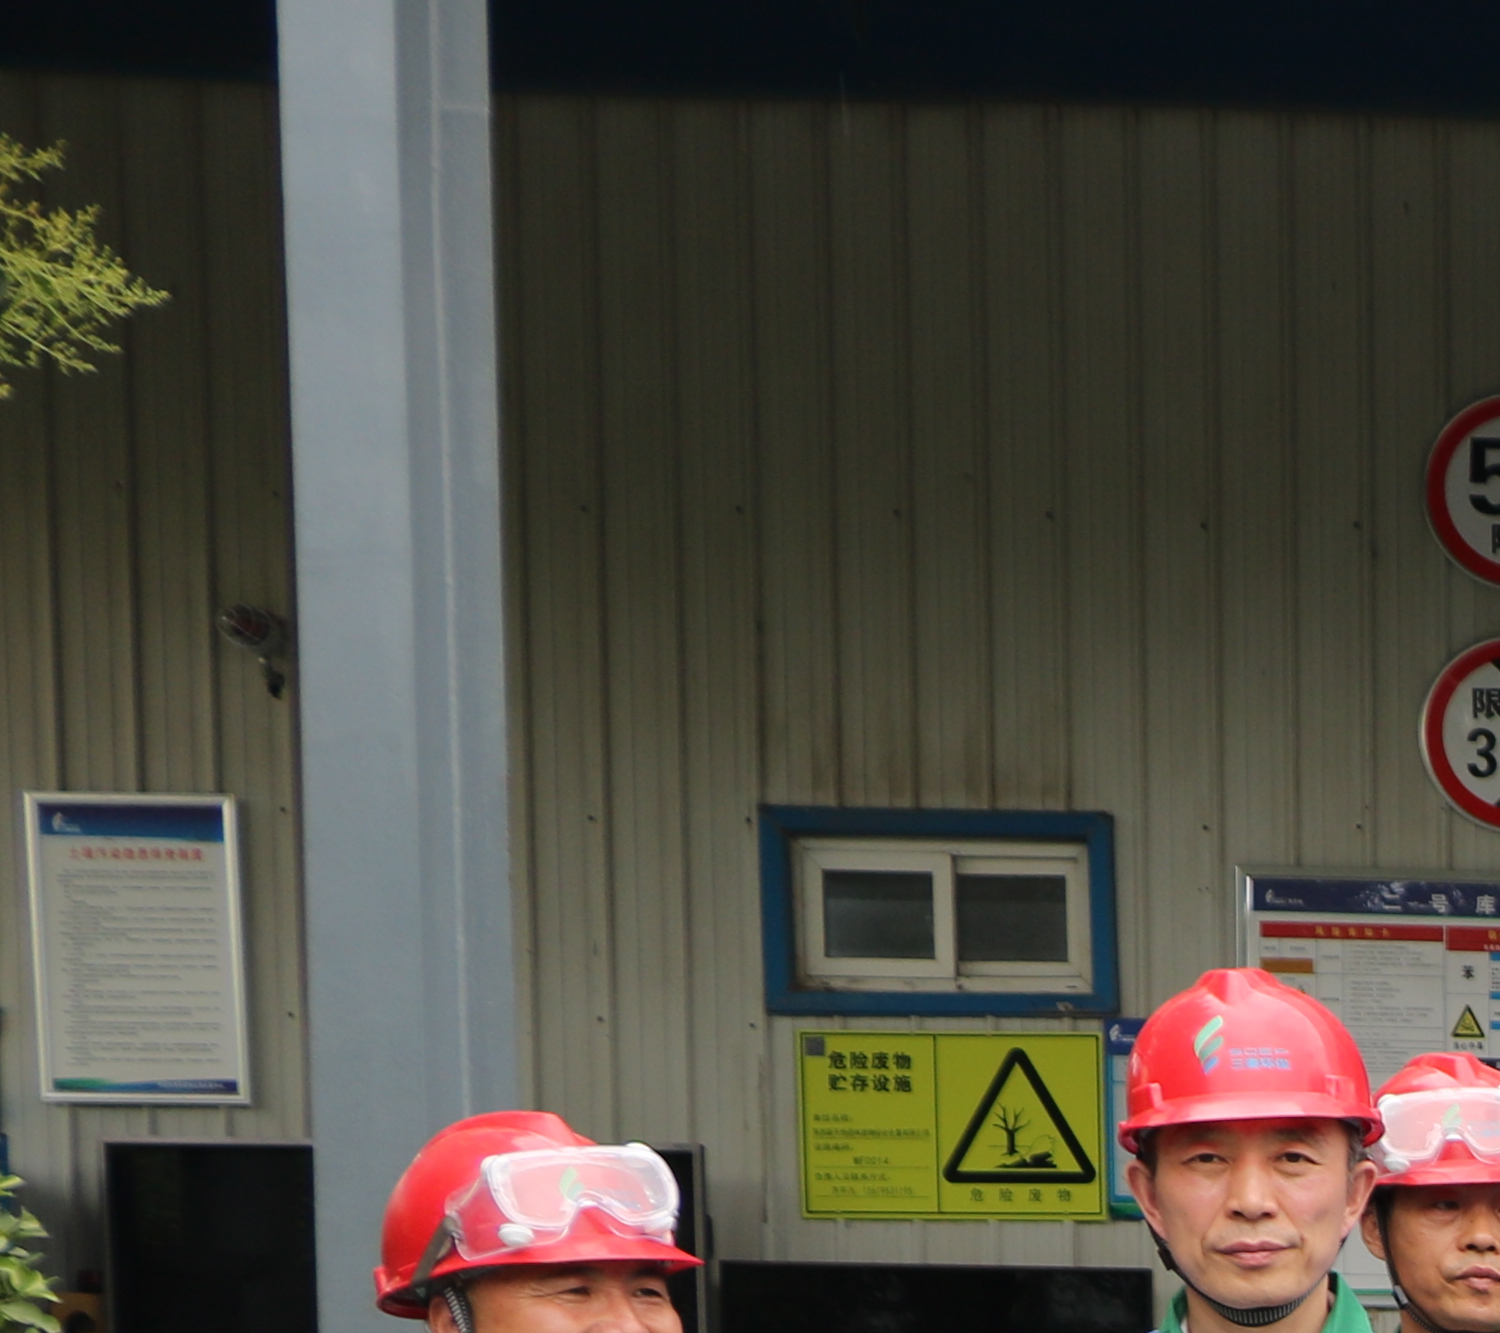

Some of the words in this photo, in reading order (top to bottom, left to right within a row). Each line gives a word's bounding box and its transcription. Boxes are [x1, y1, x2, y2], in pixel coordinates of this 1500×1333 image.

[1381, 893, 1496, 915] 二号库
[828, 1051, 912, 1070] 危险废物
[828, 1074, 912, 1092] 贮存设施
[971, 1187, 1071, 1202] 危险废物
